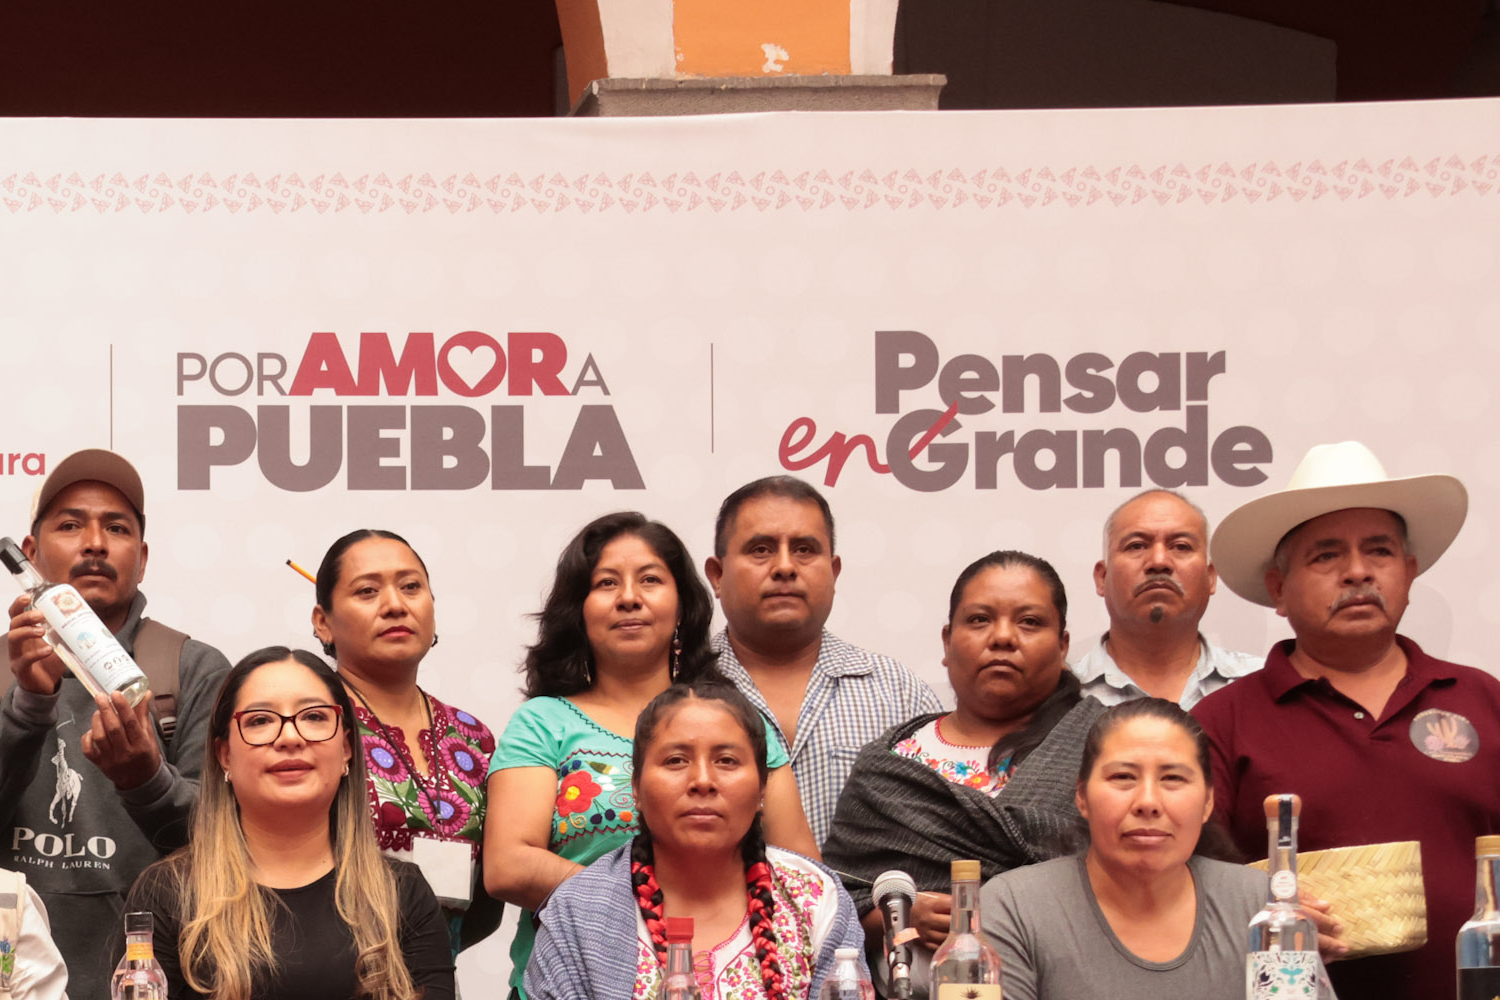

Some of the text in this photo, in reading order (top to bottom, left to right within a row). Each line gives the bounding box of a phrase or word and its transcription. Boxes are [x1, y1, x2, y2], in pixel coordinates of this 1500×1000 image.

[178, 331, 610, 397] POR AMOR A
[875, 331, 1225, 415] Pensar
[178, 405, 646, 492] PUEBLA
[779, 404, 1273, 492] en Grande
[11, 827, 116, 859] POLO
[13, 855, 110, 870] RALPH LAUREN
